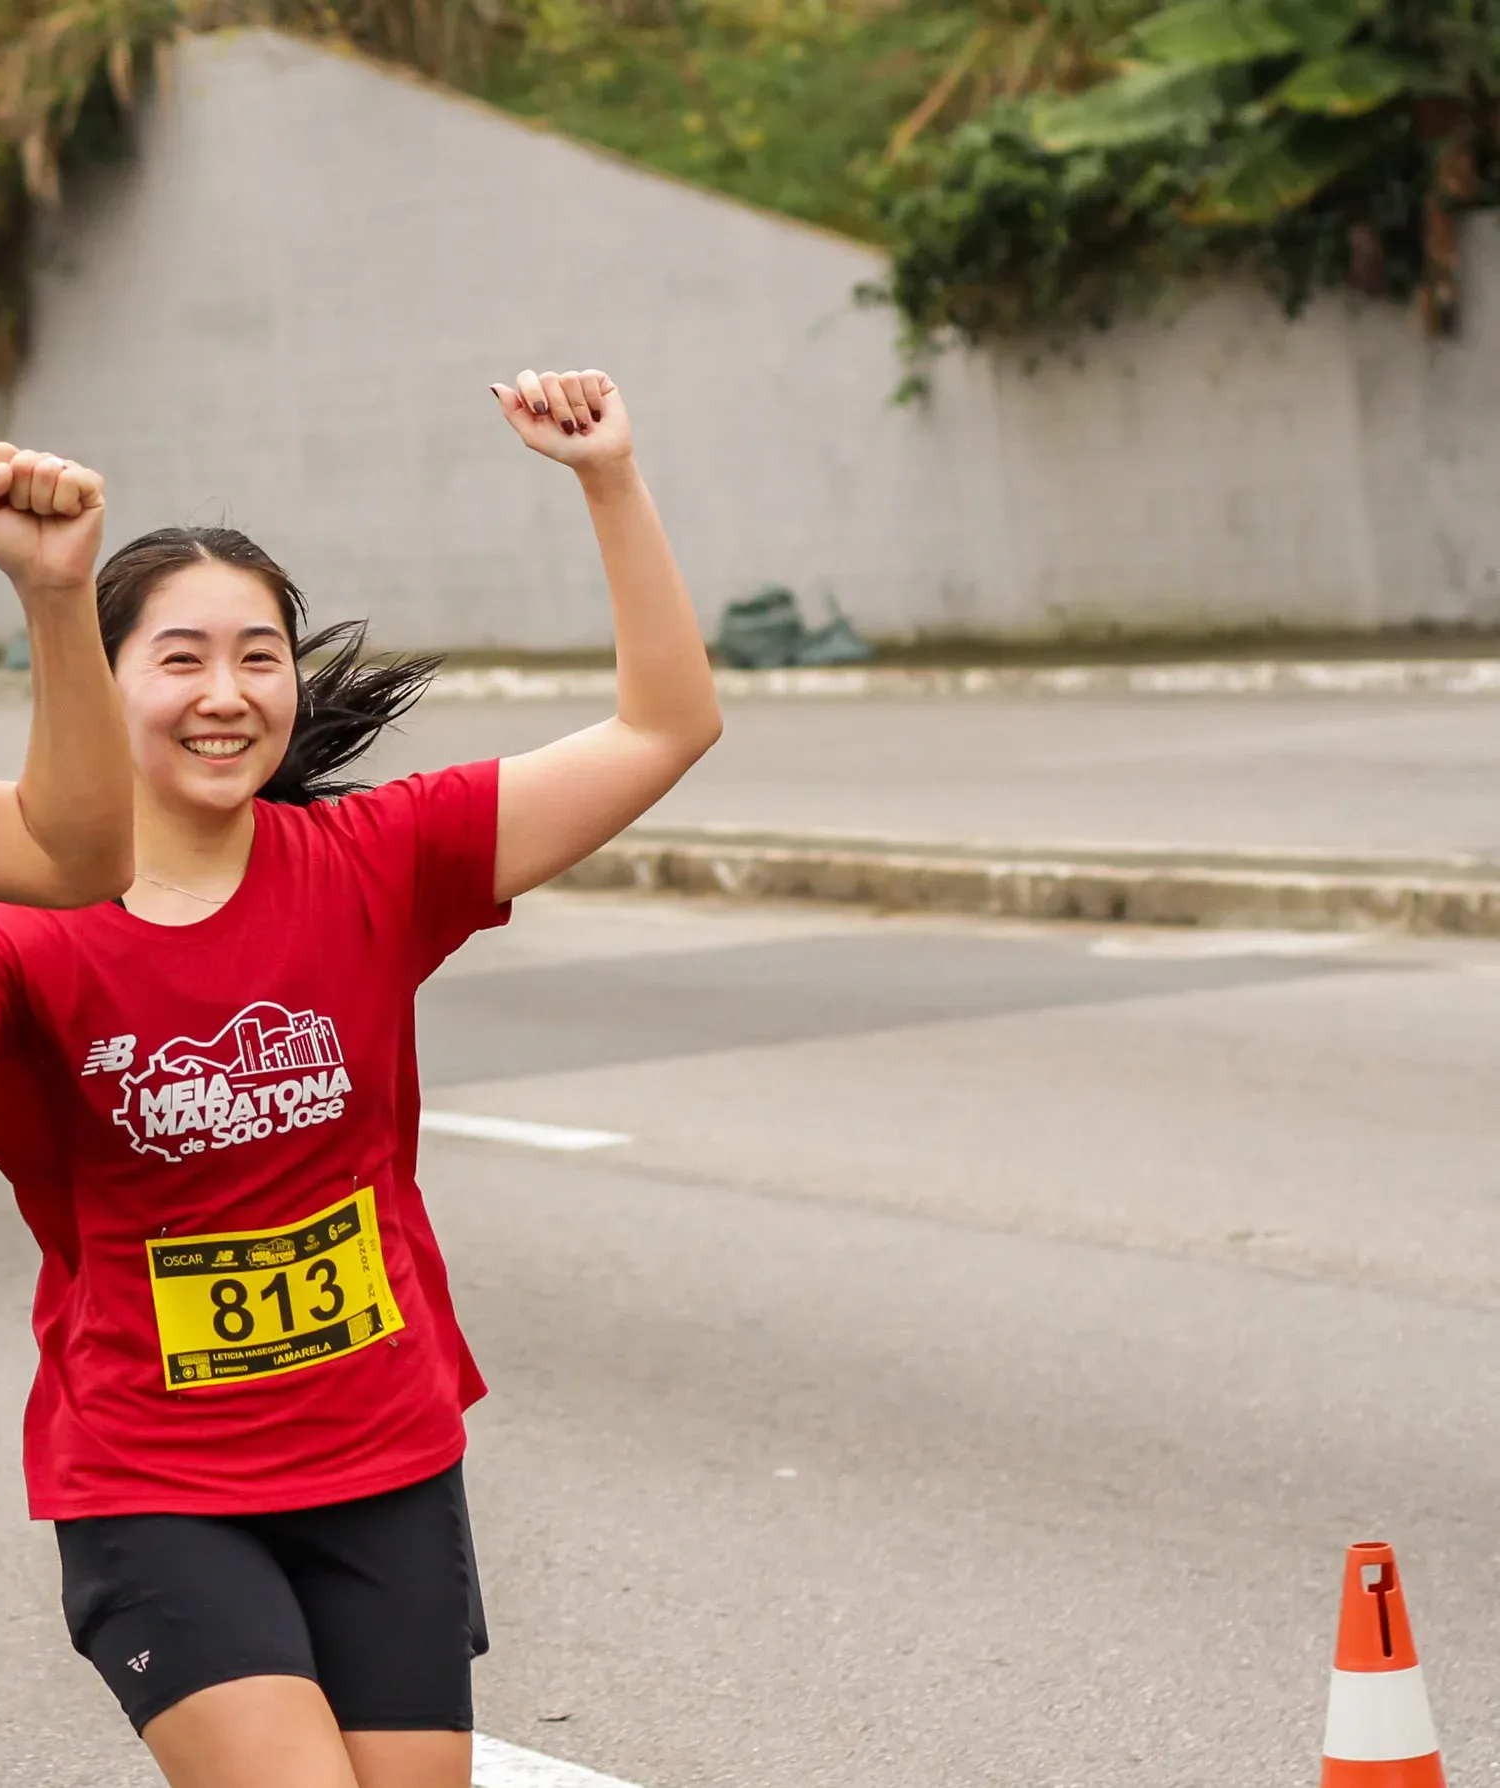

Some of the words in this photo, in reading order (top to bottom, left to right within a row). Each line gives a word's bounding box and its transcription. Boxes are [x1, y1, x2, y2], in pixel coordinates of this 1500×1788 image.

[81, 1034, 137, 1076] NB
[140, 1073, 234, 1117] MEIA
[146, 1066, 353, 1138] MARATONA
[180, 1138, 206, 1155] de
[211, 1115, 273, 1149] São
[276, 1090, 345, 1133] José
[163, 1254, 204, 1267] OSCAR
[210, 1259, 344, 1342] 813
[213, 1351, 244, 1361] LETICIA
[245, 1342, 292, 1357] HASEGAWA
